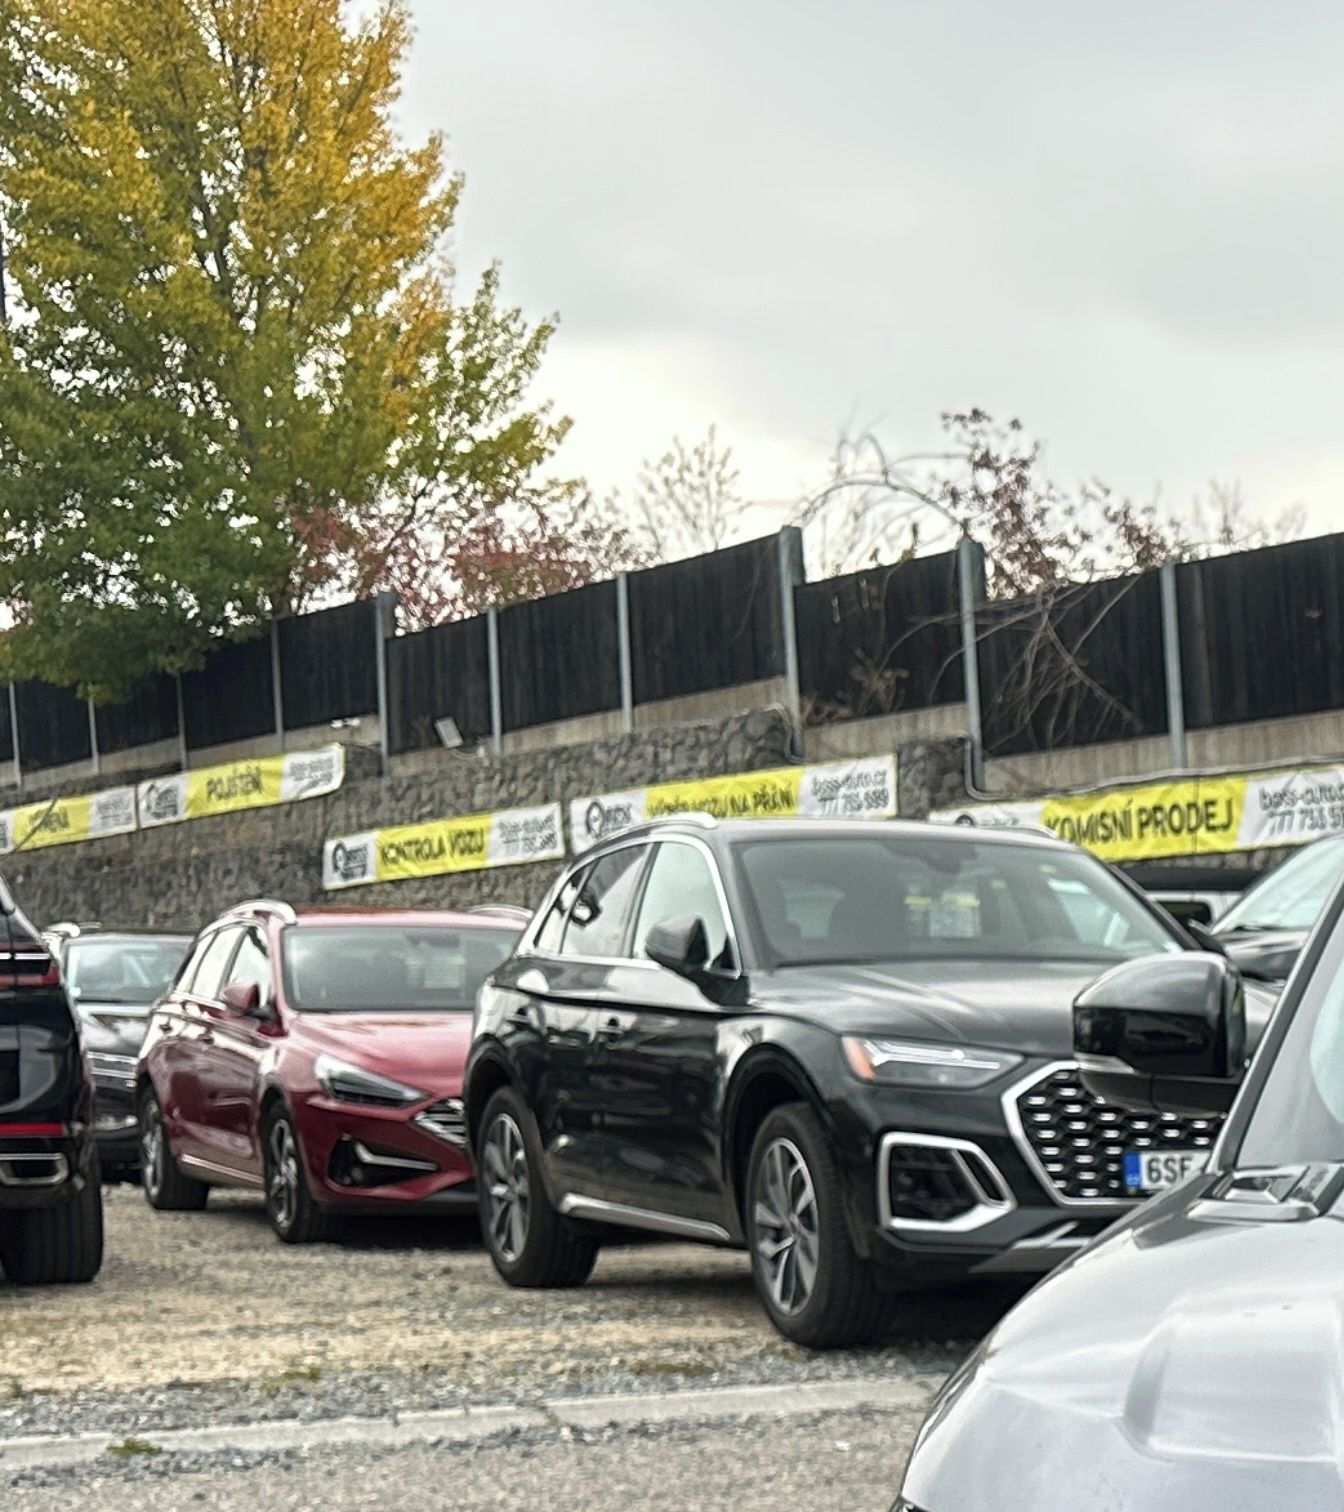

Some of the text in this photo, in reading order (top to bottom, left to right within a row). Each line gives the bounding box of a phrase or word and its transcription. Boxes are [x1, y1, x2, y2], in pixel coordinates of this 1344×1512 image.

[1044, 798, 1234, 847] KOMISNÍ PRODEJ
[380, 837, 446, 866] KONTROLA
